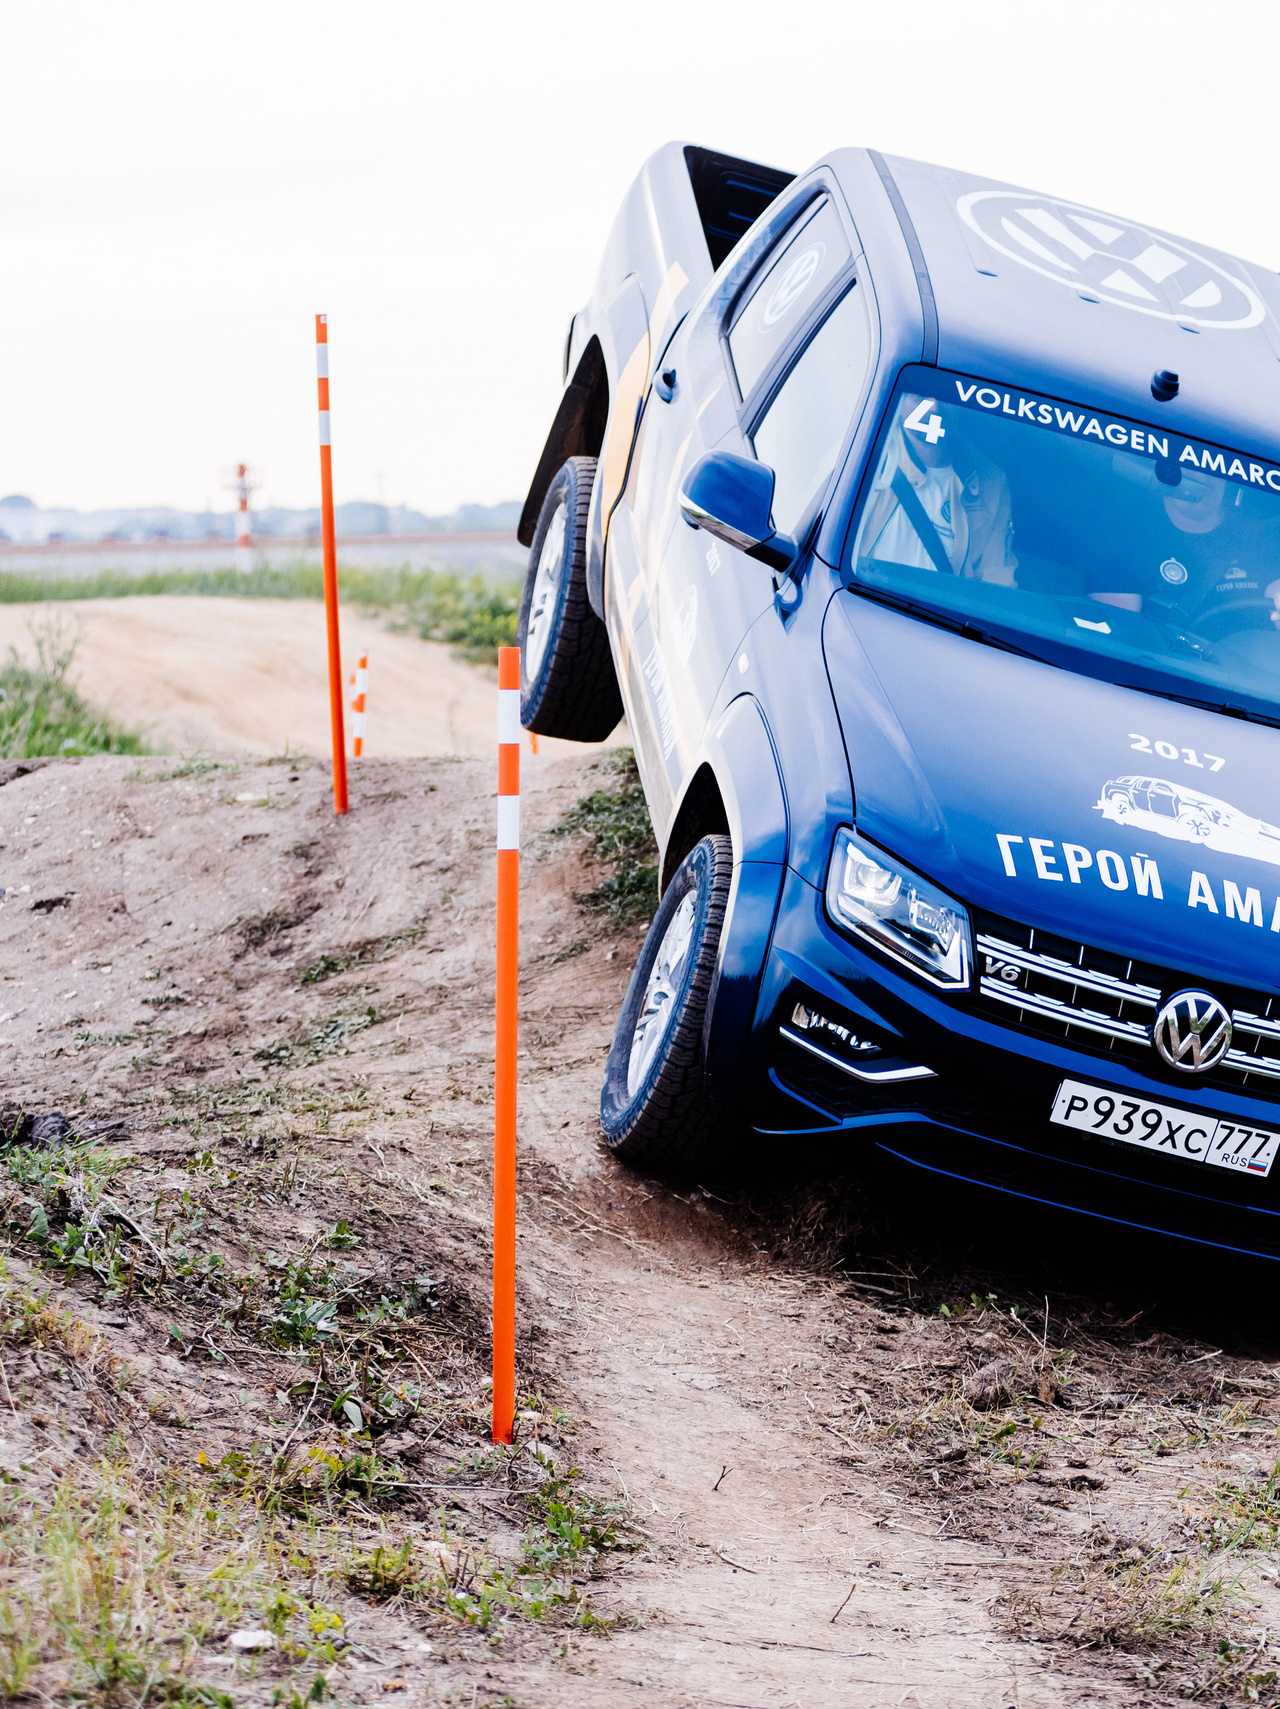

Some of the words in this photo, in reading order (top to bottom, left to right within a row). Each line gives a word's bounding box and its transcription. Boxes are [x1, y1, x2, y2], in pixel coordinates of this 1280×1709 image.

[903, 397, 946, 445] 4
[954, 380, 1170, 459] VOLKSWAGEN
[1127, 733, 1226, 772] 2017
[995, 833, 1164, 900] ГЕРОЙ
[985, 956, 1021, 982] V6
[1215, 1124, 1272, 1159] 777
[1220, 1153, 1248, 1167] RUS
